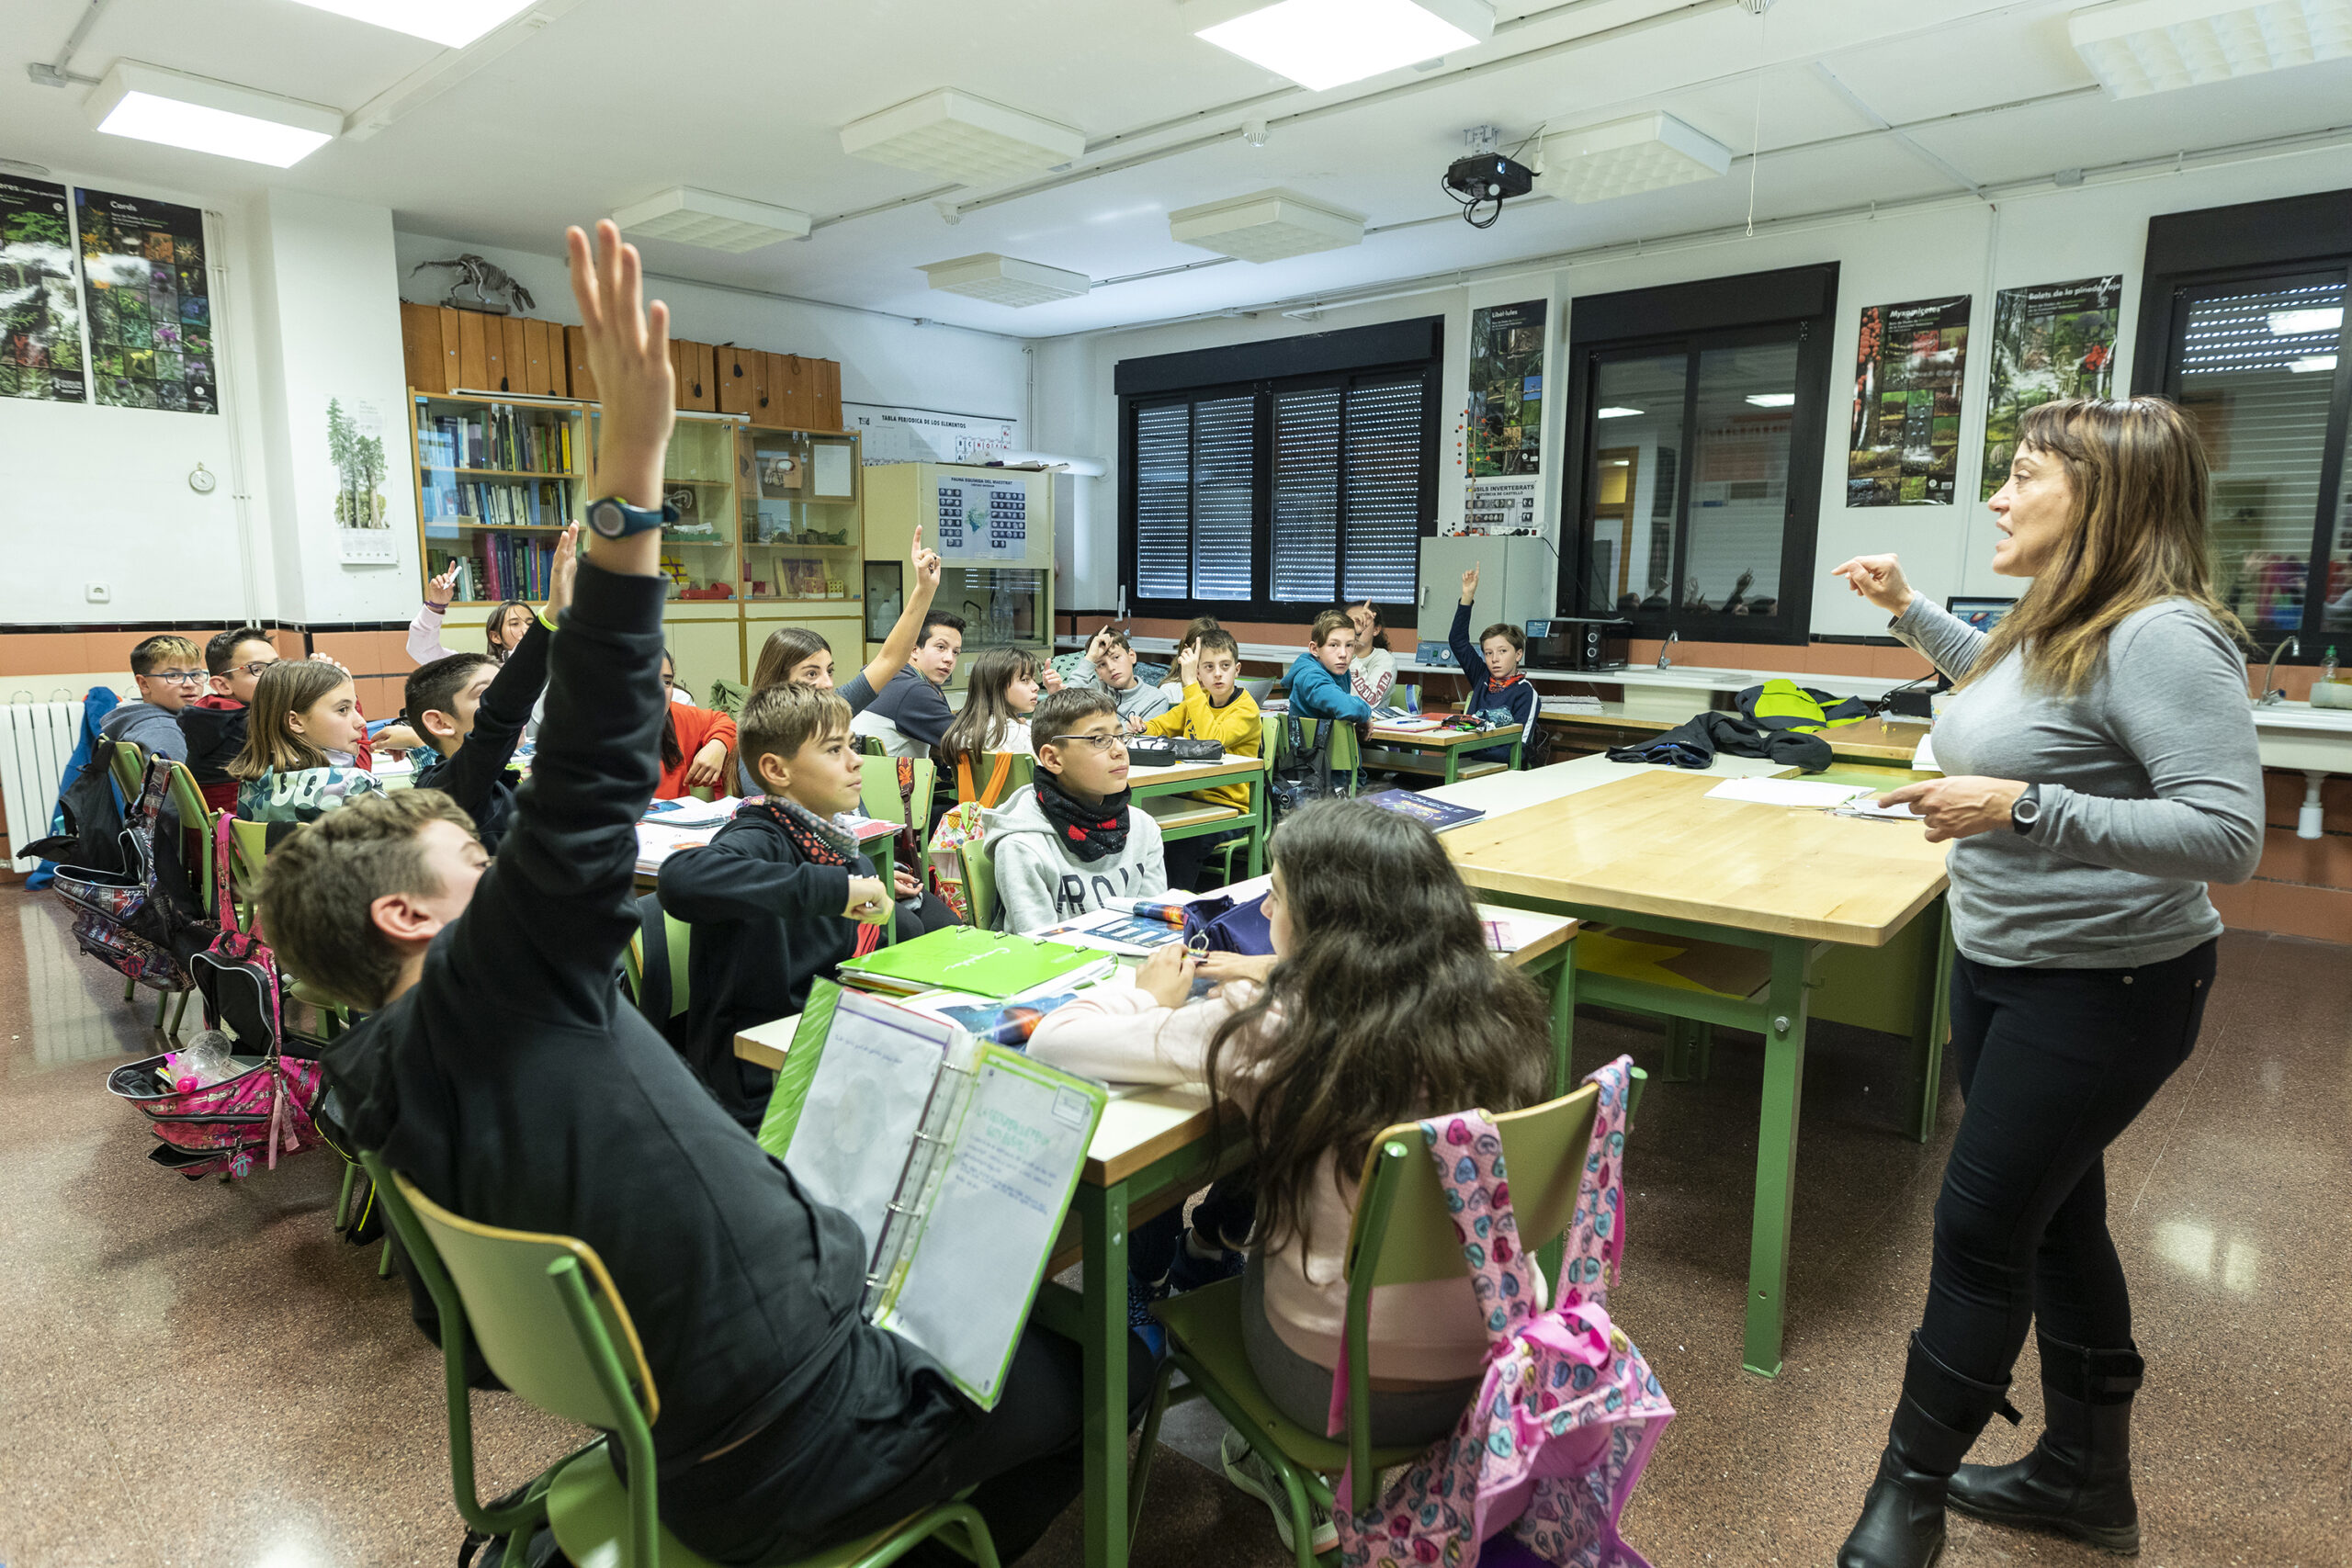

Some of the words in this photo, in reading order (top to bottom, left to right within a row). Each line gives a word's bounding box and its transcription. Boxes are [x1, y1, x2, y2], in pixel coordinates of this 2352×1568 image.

[2028, 292, 2052, 301] Bolets
[2053, 289, 2064, 298] de
[2064, 288, 2074, 296] la
[941, 420, 967, 429] ELEMENTOS
